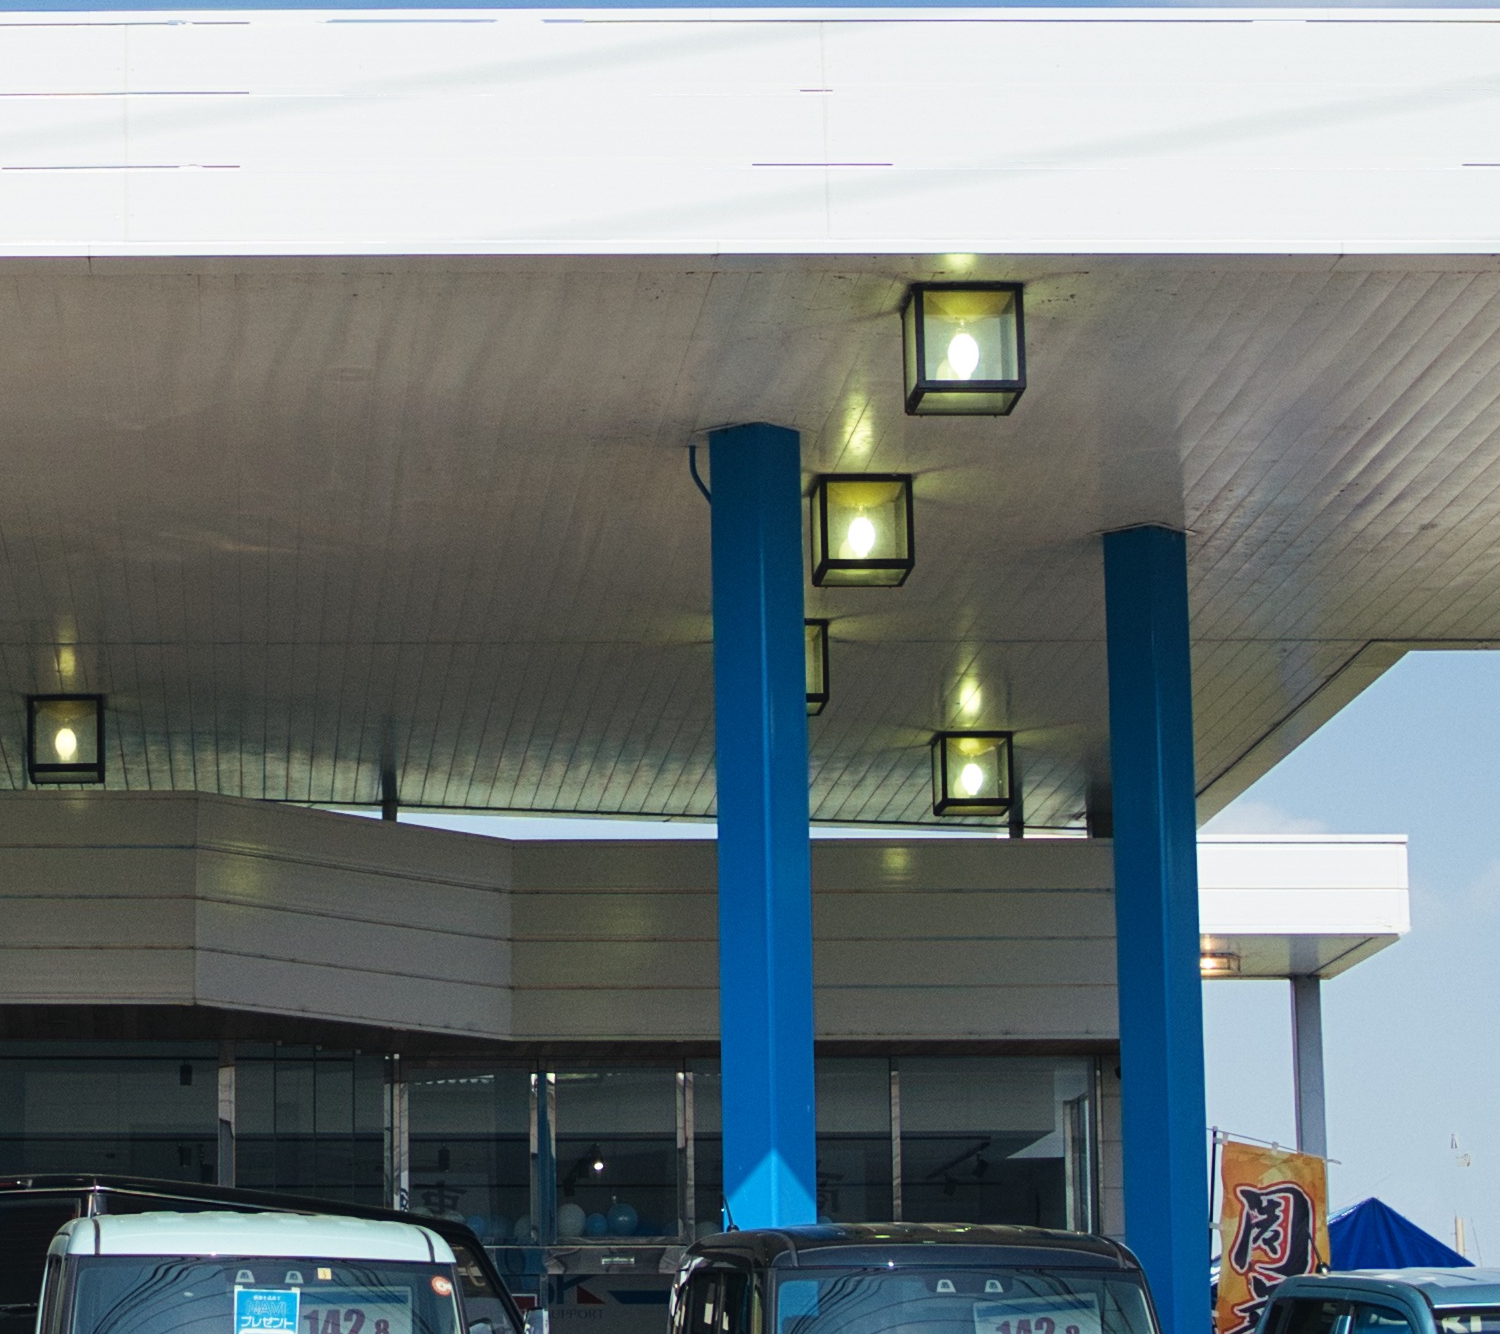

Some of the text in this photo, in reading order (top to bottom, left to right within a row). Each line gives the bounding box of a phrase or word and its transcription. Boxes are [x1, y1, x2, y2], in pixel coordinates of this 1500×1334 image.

[241, 1315, 294, 1329] プレゼント
